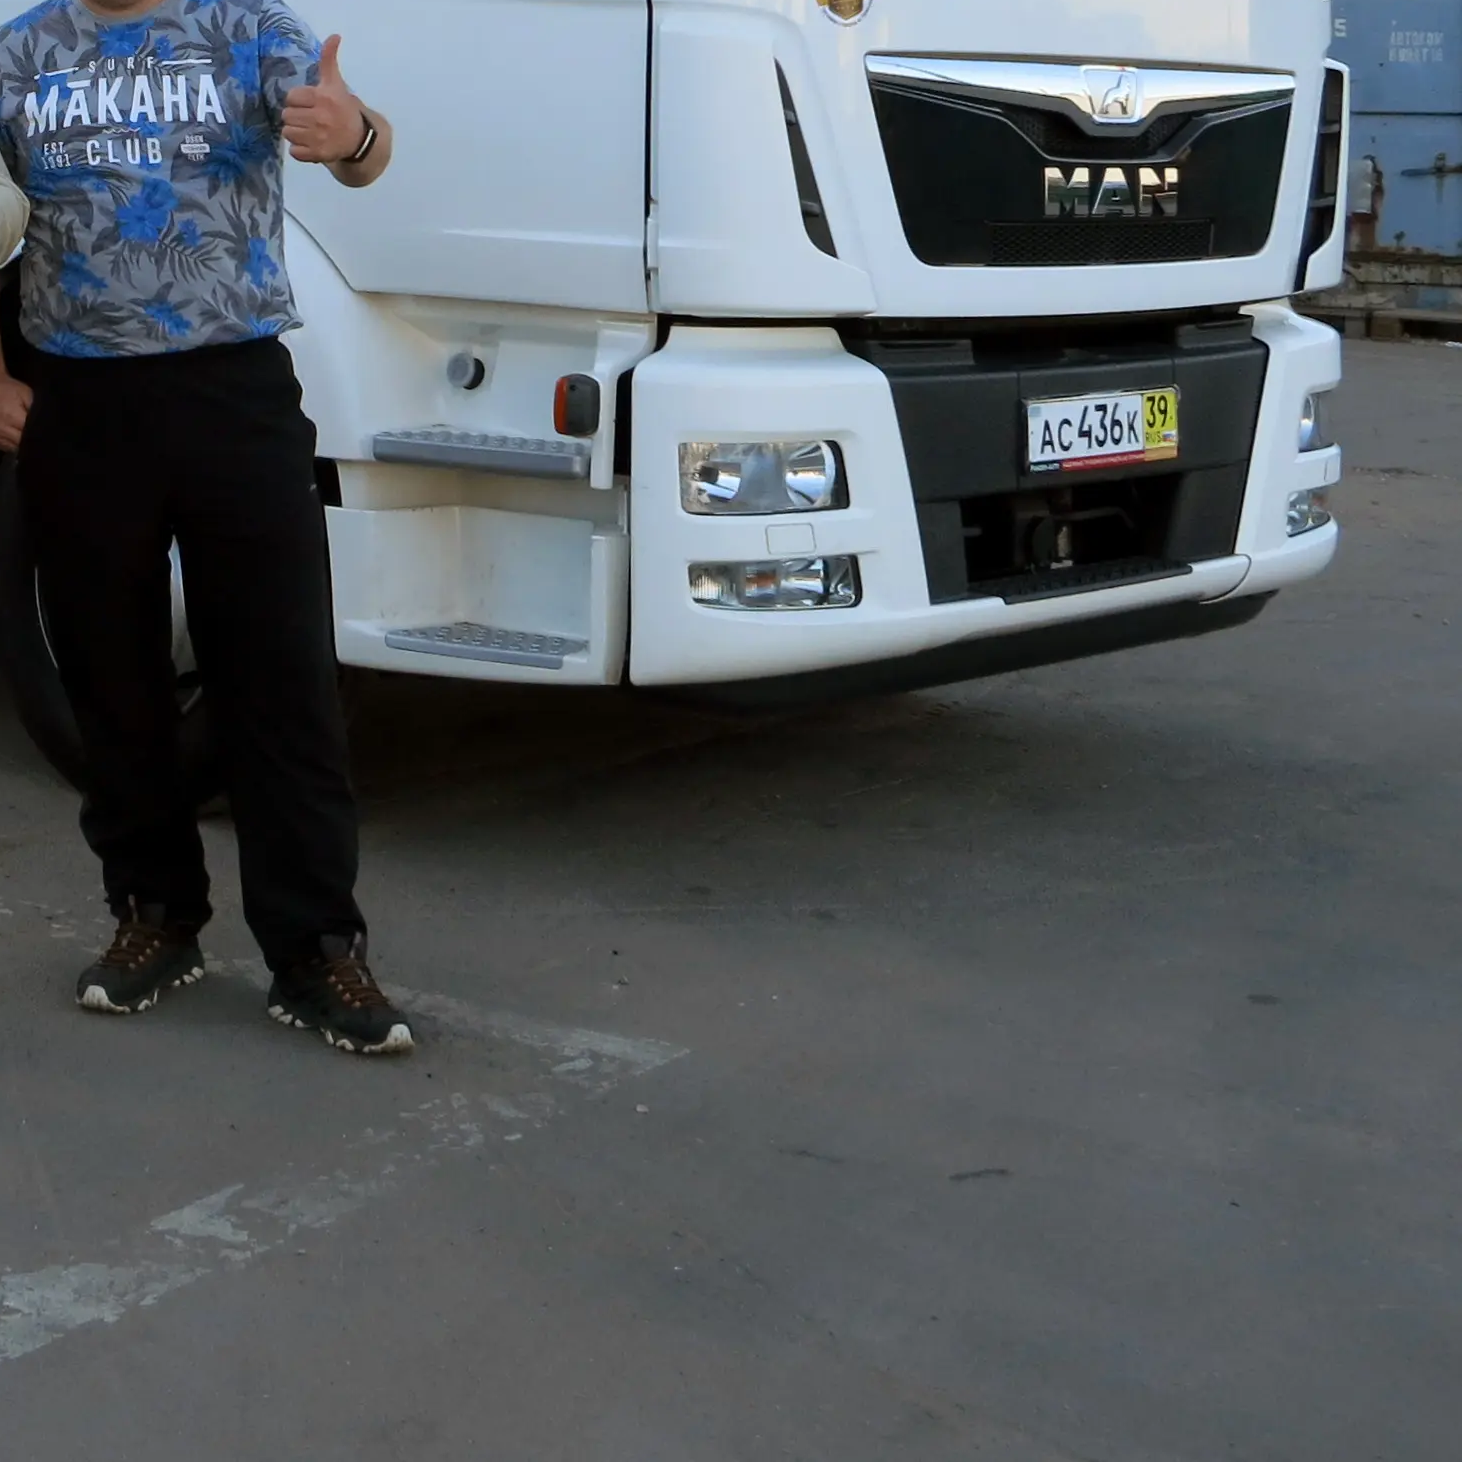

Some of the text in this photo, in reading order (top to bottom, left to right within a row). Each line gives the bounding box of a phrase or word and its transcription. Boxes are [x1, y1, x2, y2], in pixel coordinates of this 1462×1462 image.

[87, 56, 155, 74] SURF
[43, 141, 66, 156] EST.
[85, 138, 163, 167] CLUB
[1043, 166, 1179, 219] MAN
[1146, 394, 1169, 429] 39
